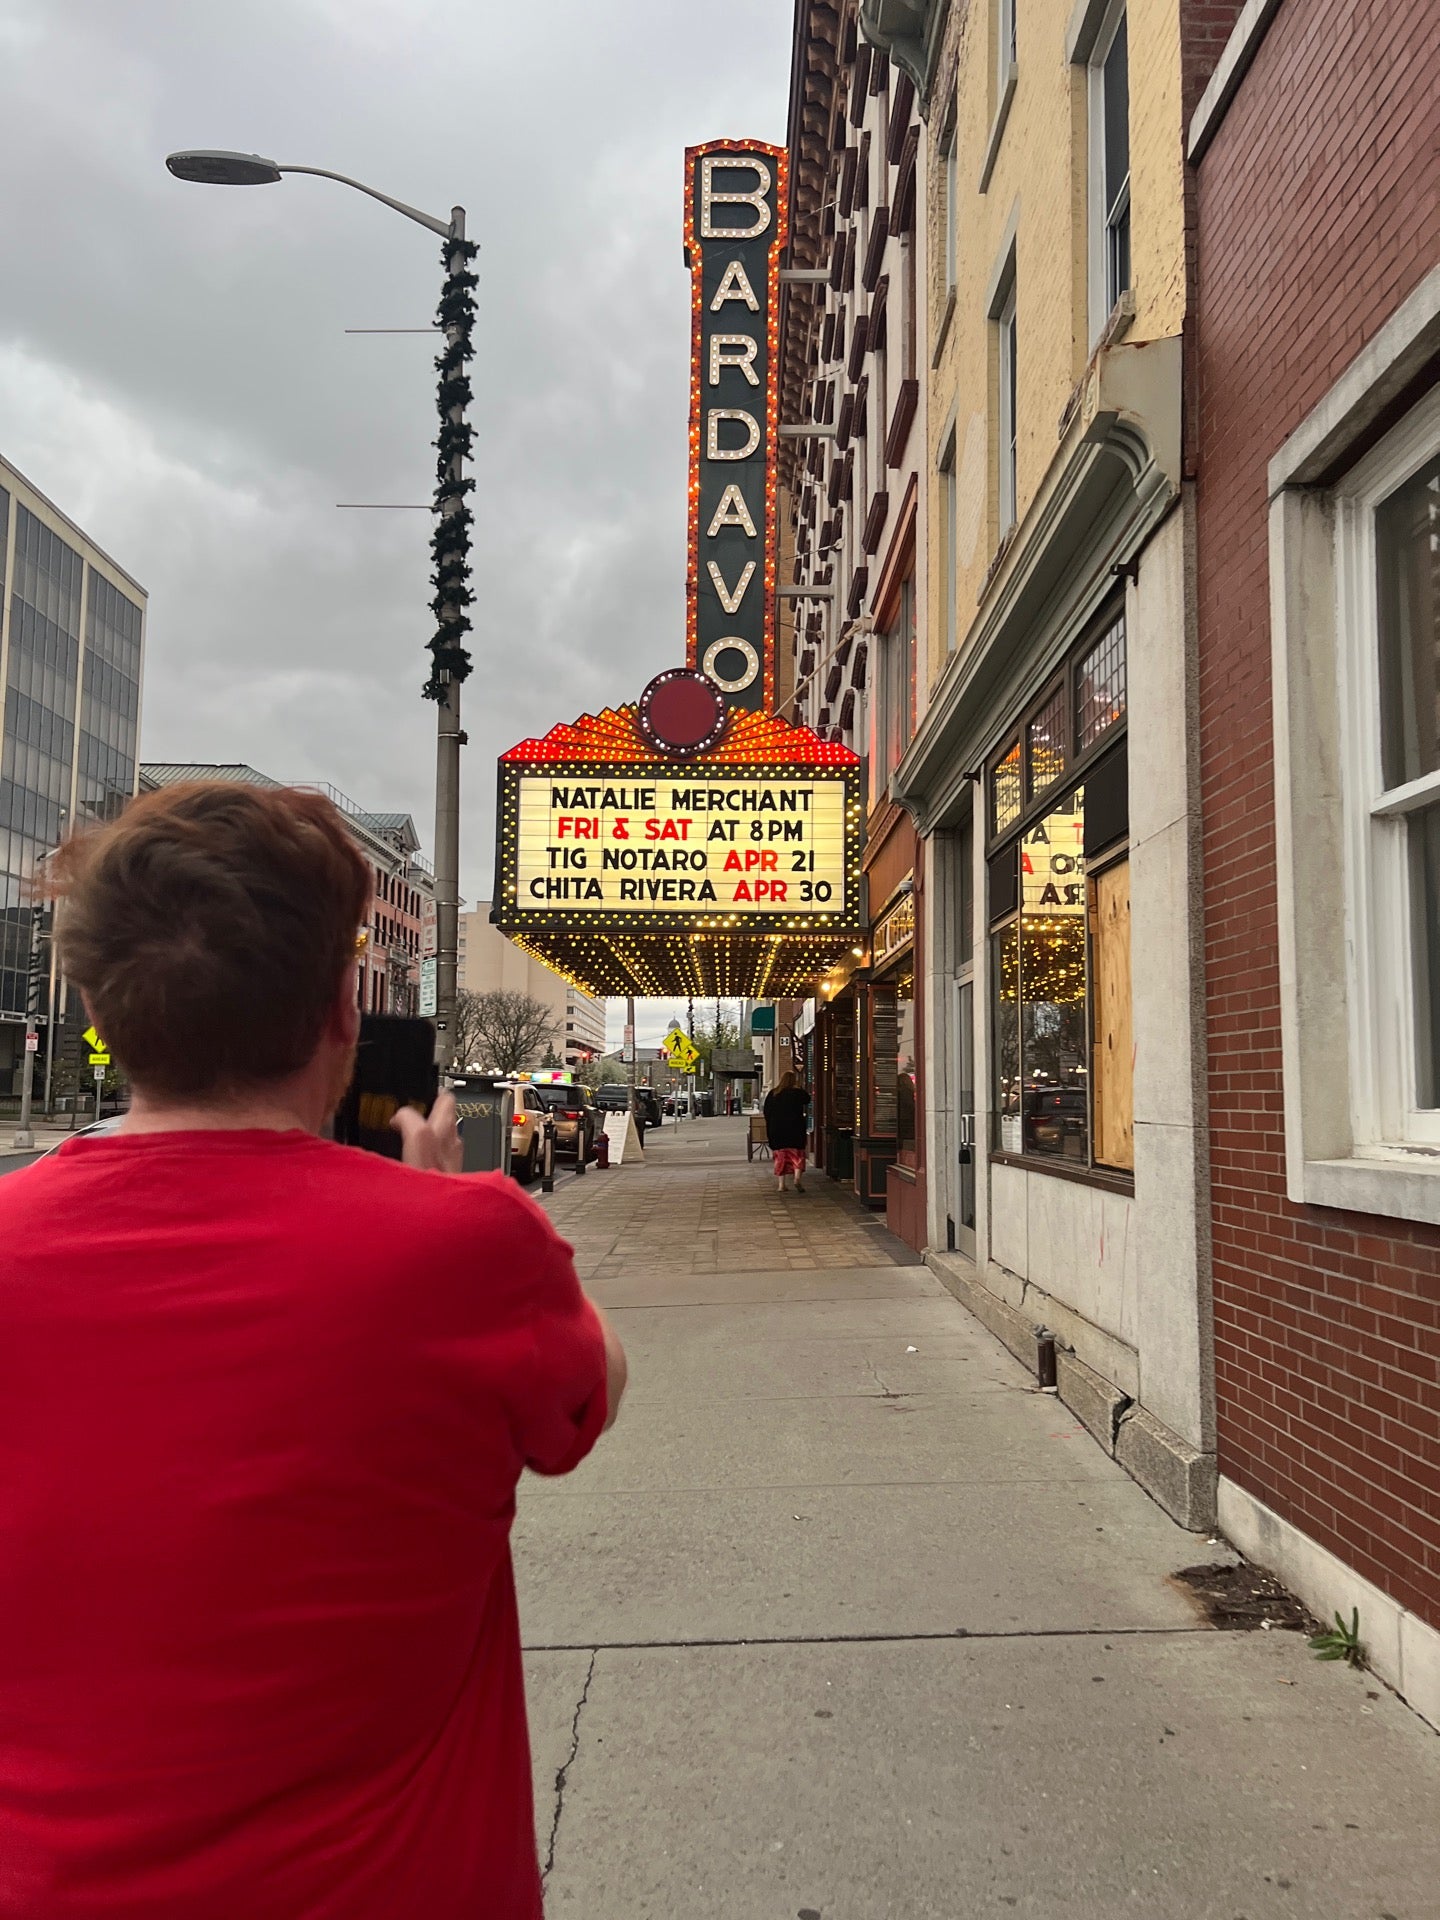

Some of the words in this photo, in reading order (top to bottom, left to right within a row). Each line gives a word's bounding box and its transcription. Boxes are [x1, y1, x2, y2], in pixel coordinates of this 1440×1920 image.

[700, 157, 771, 693] BARDAVO
[551, 787, 655, 810] NATALIE
[672, 789, 813, 811] MERCHANT
[558, 817, 598, 839] FRI
[613, 818, 629, 839] &
[645, 819, 692, 840] SAT
[708, 820, 739, 841] AT
[751, 820, 802, 841] 8PM
[547, 847, 586, 869] TIG
[603, 849, 707, 870] NOTARO
[723, 850, 777, 872] APR
[792, 851, 814, 871] 21
[530, 878, 603, 899] CHITA
[621, 879, 716, 901] RIVERA
[733, 880, 787, 903] APR
[800, 881, 831, 902] 30
